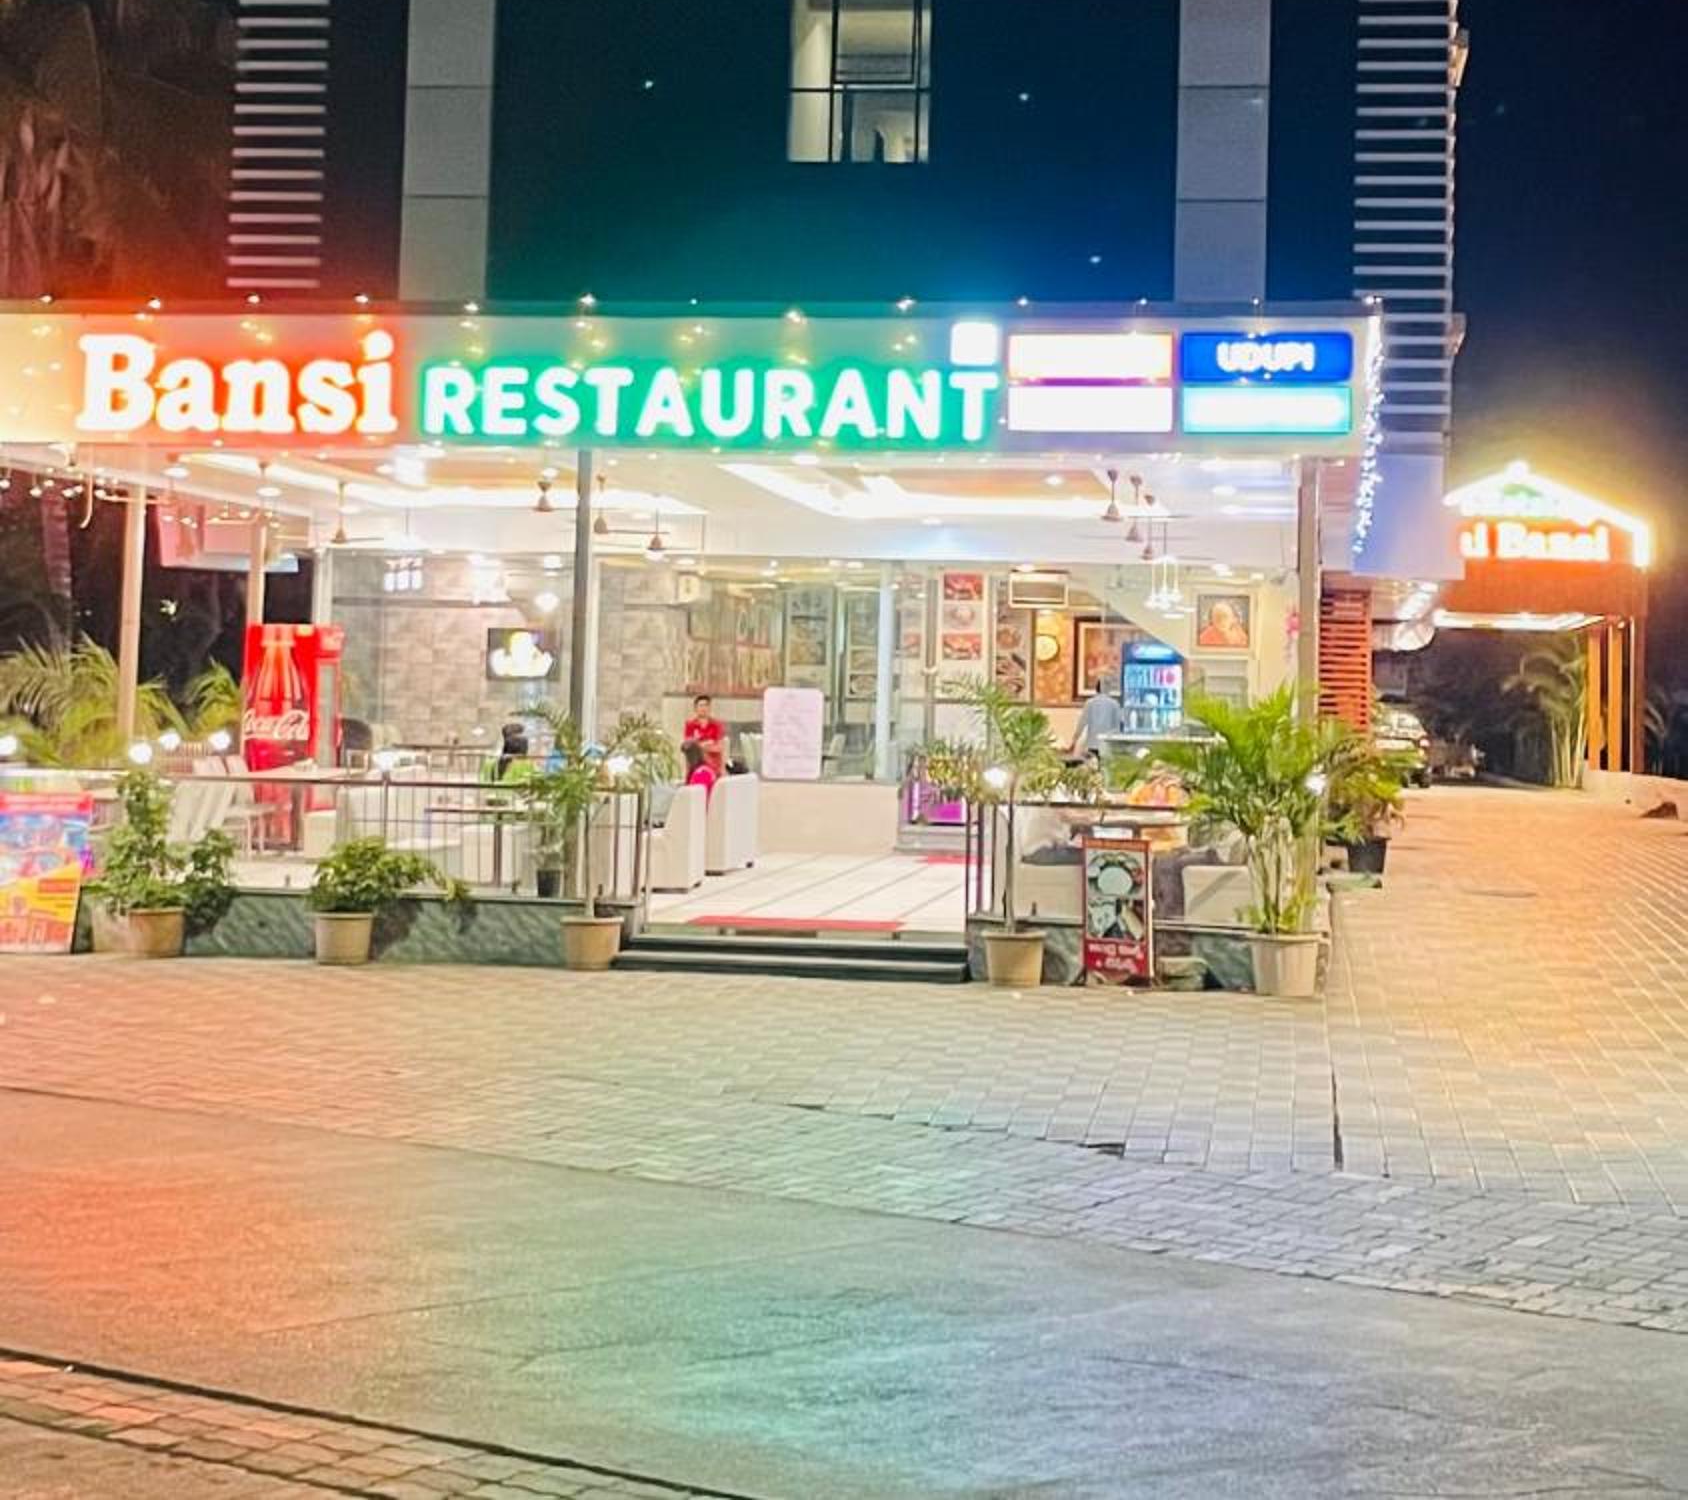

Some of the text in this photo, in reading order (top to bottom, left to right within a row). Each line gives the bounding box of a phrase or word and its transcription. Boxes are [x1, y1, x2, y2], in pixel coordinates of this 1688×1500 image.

[76, 330, 998, 440] Bansi RESTAURANT
[1216, 342, 1315, 372] UDUPI
